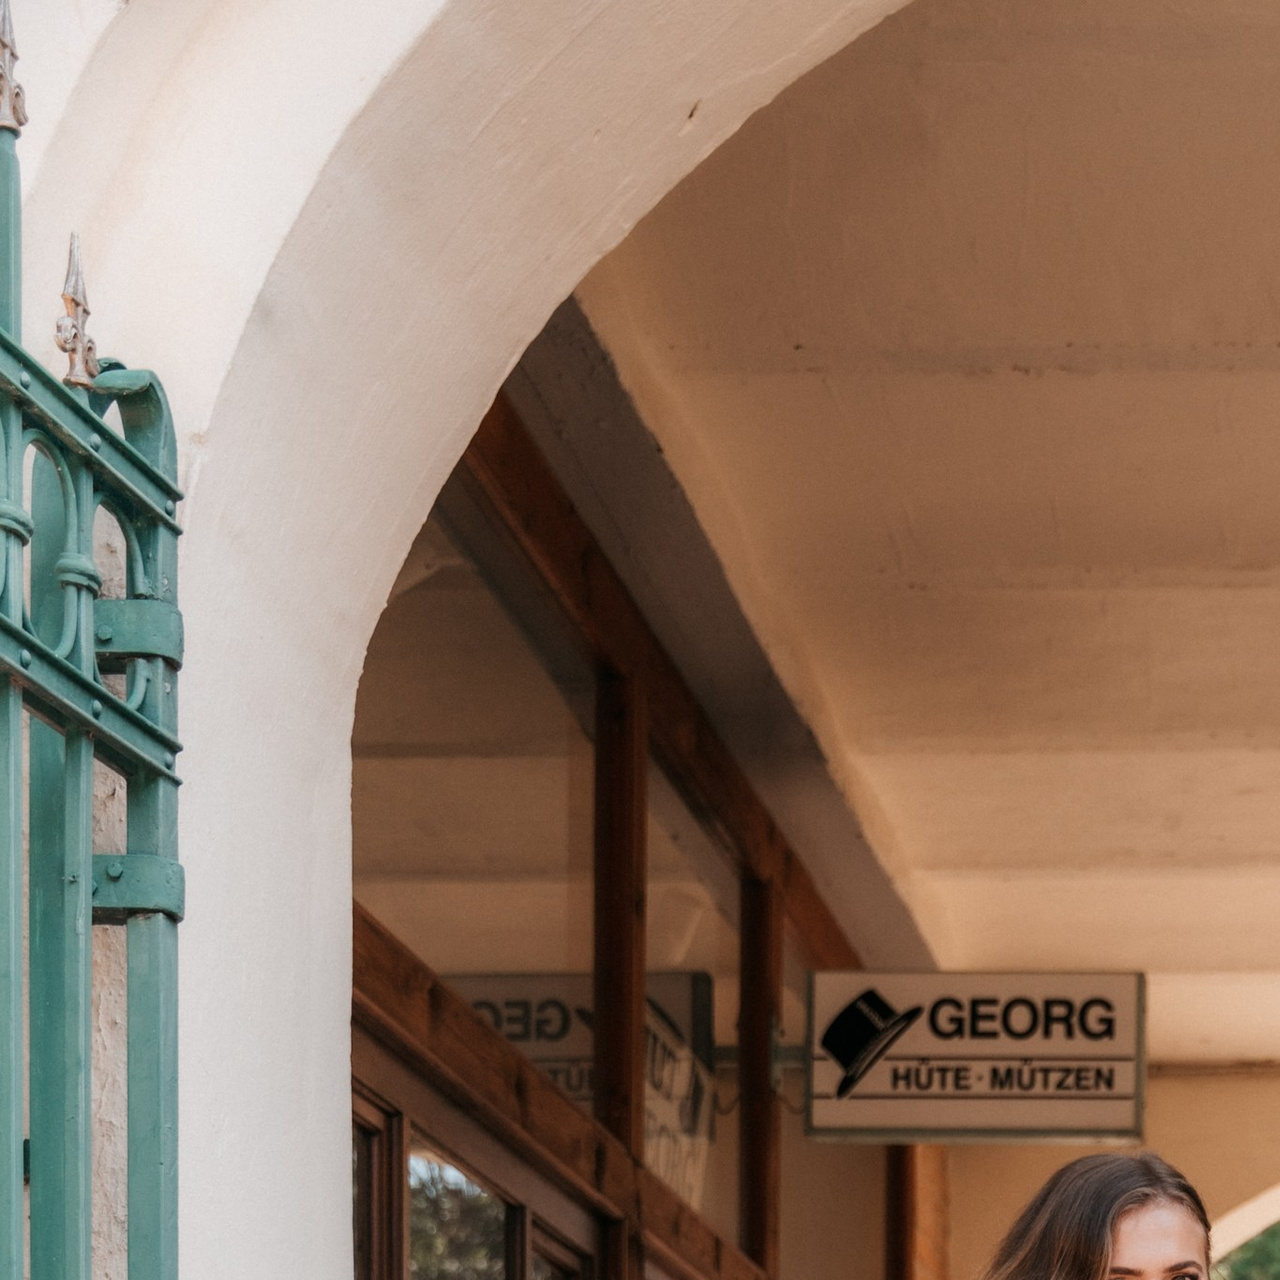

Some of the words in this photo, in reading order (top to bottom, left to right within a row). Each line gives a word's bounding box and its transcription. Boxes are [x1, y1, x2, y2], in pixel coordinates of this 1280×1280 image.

[928, 997, 1117, 1041] GEORG
[891, 1058, 972, 1092] HÜTE
[989, 1058, 1115, 1092] MÜTZEN
